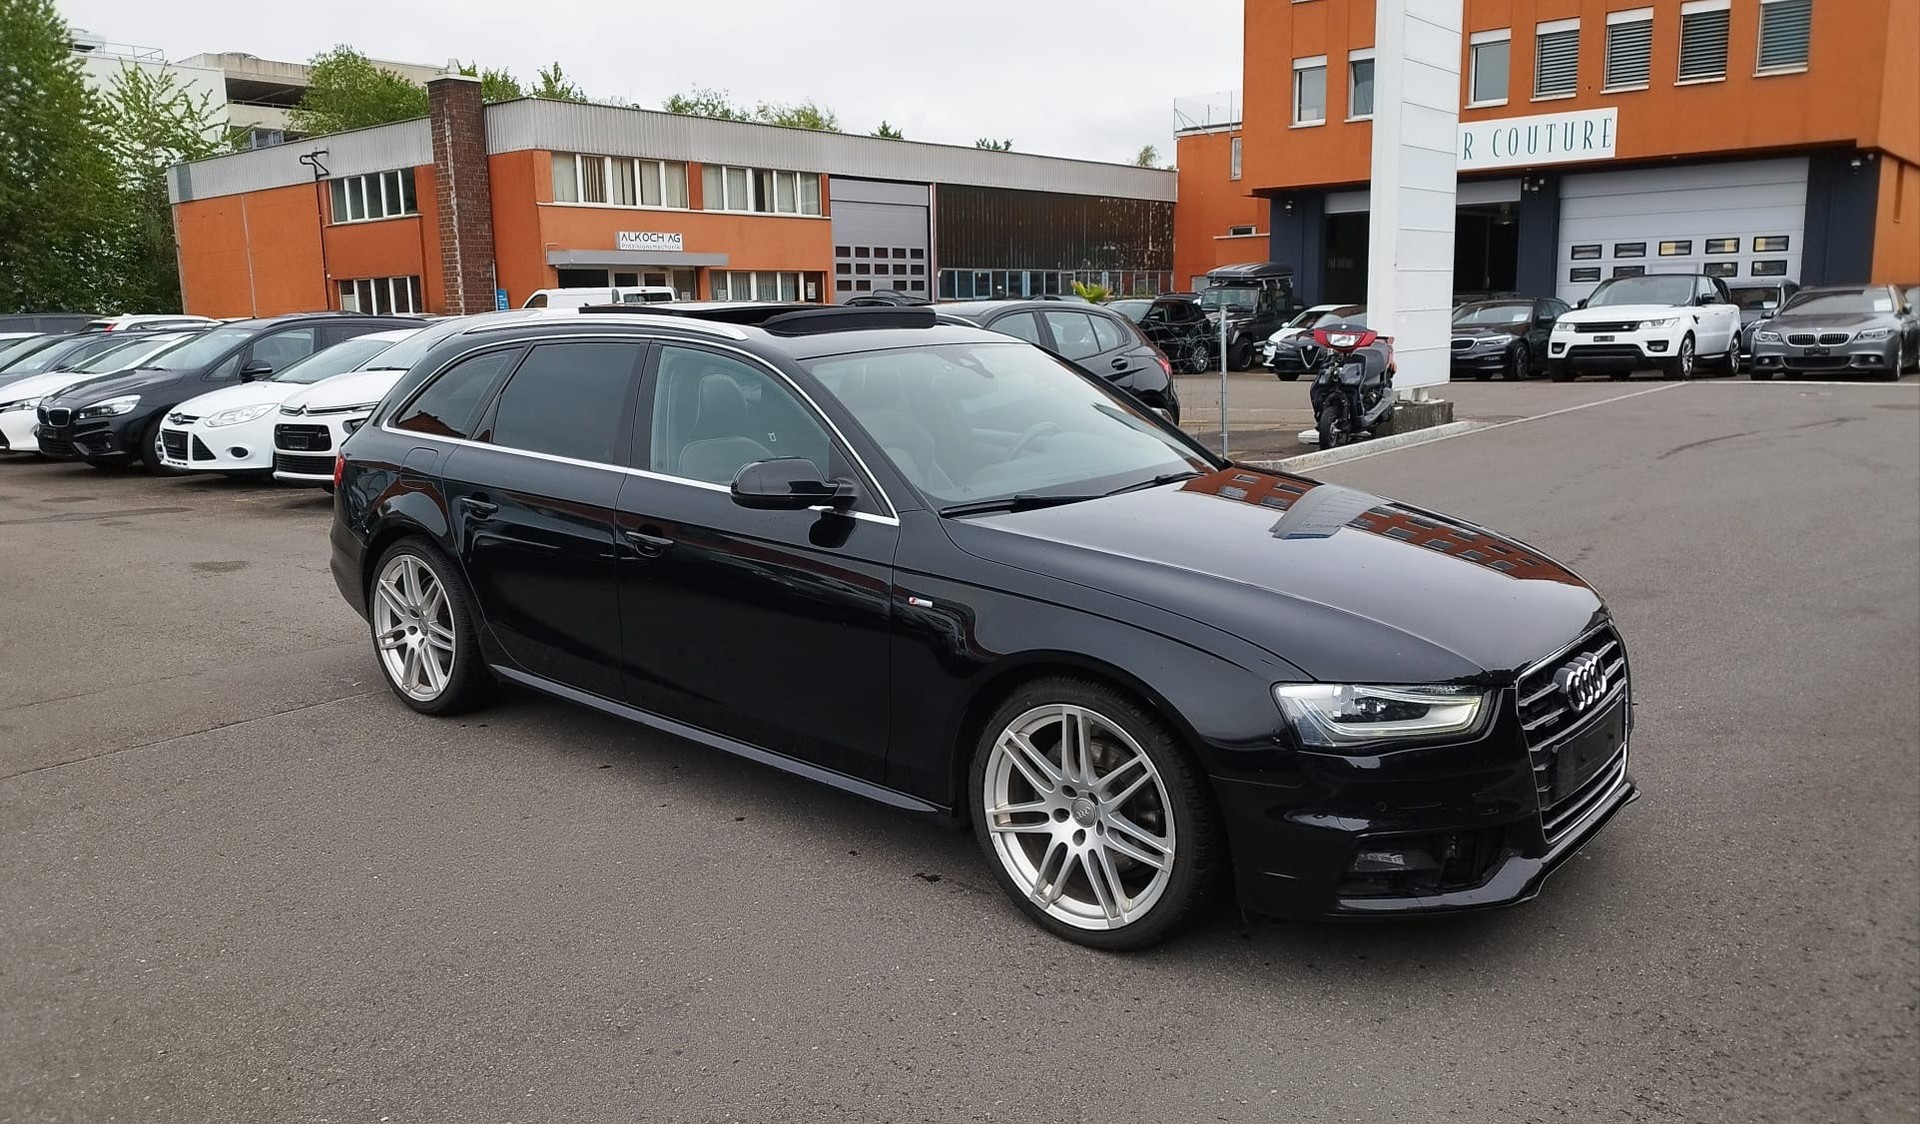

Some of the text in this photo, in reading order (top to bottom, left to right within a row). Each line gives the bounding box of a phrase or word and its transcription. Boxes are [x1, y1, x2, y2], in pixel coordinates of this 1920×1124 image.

[1492, 118, 1612, 157] COUTURE
[621, 232, 681, 243] ALKOCH AG
